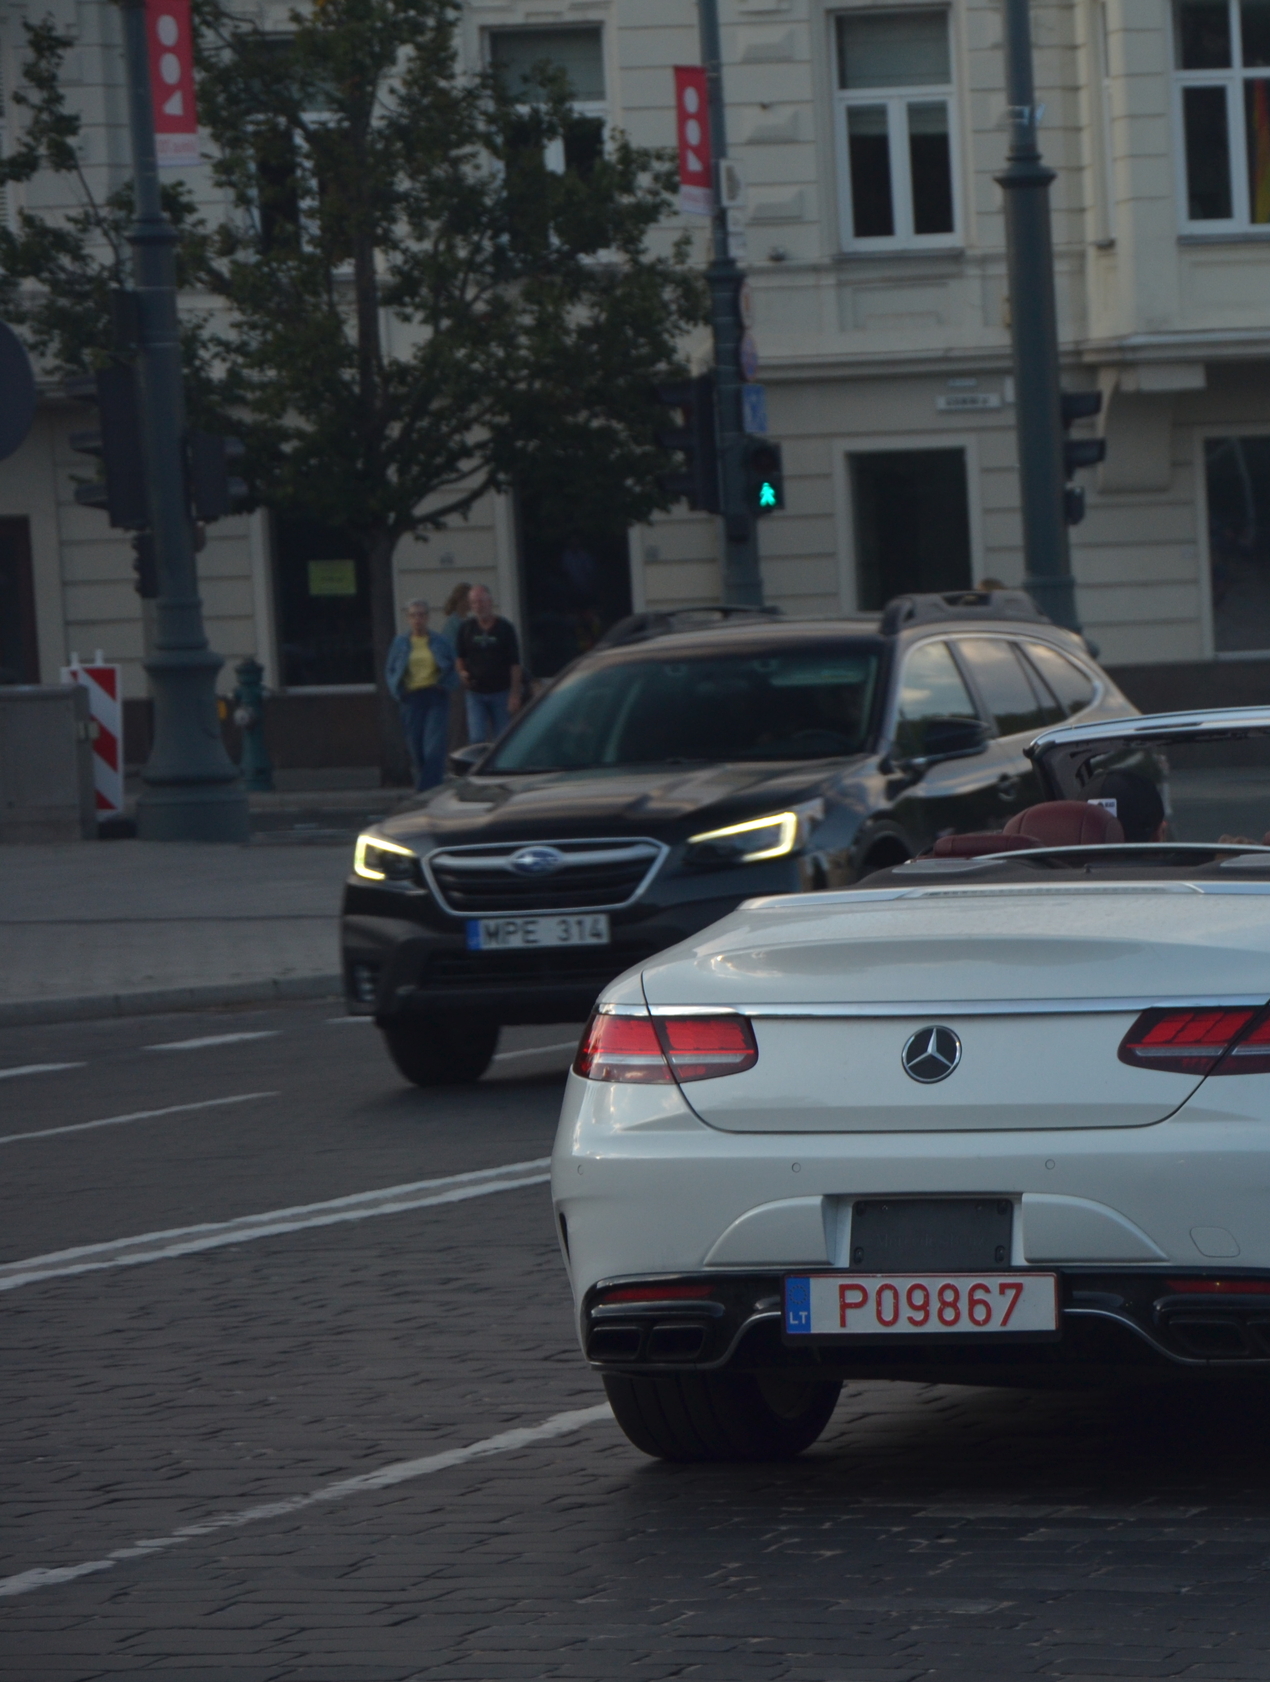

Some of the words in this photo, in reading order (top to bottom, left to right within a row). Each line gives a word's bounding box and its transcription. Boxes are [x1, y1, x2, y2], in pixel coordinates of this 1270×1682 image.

[483, 919, 540, 945] MPE
[557, 917, 604, 941] 314
[789, 1311, 808, 1325] LT
[839, 1282, 1023, 1328] P09867
